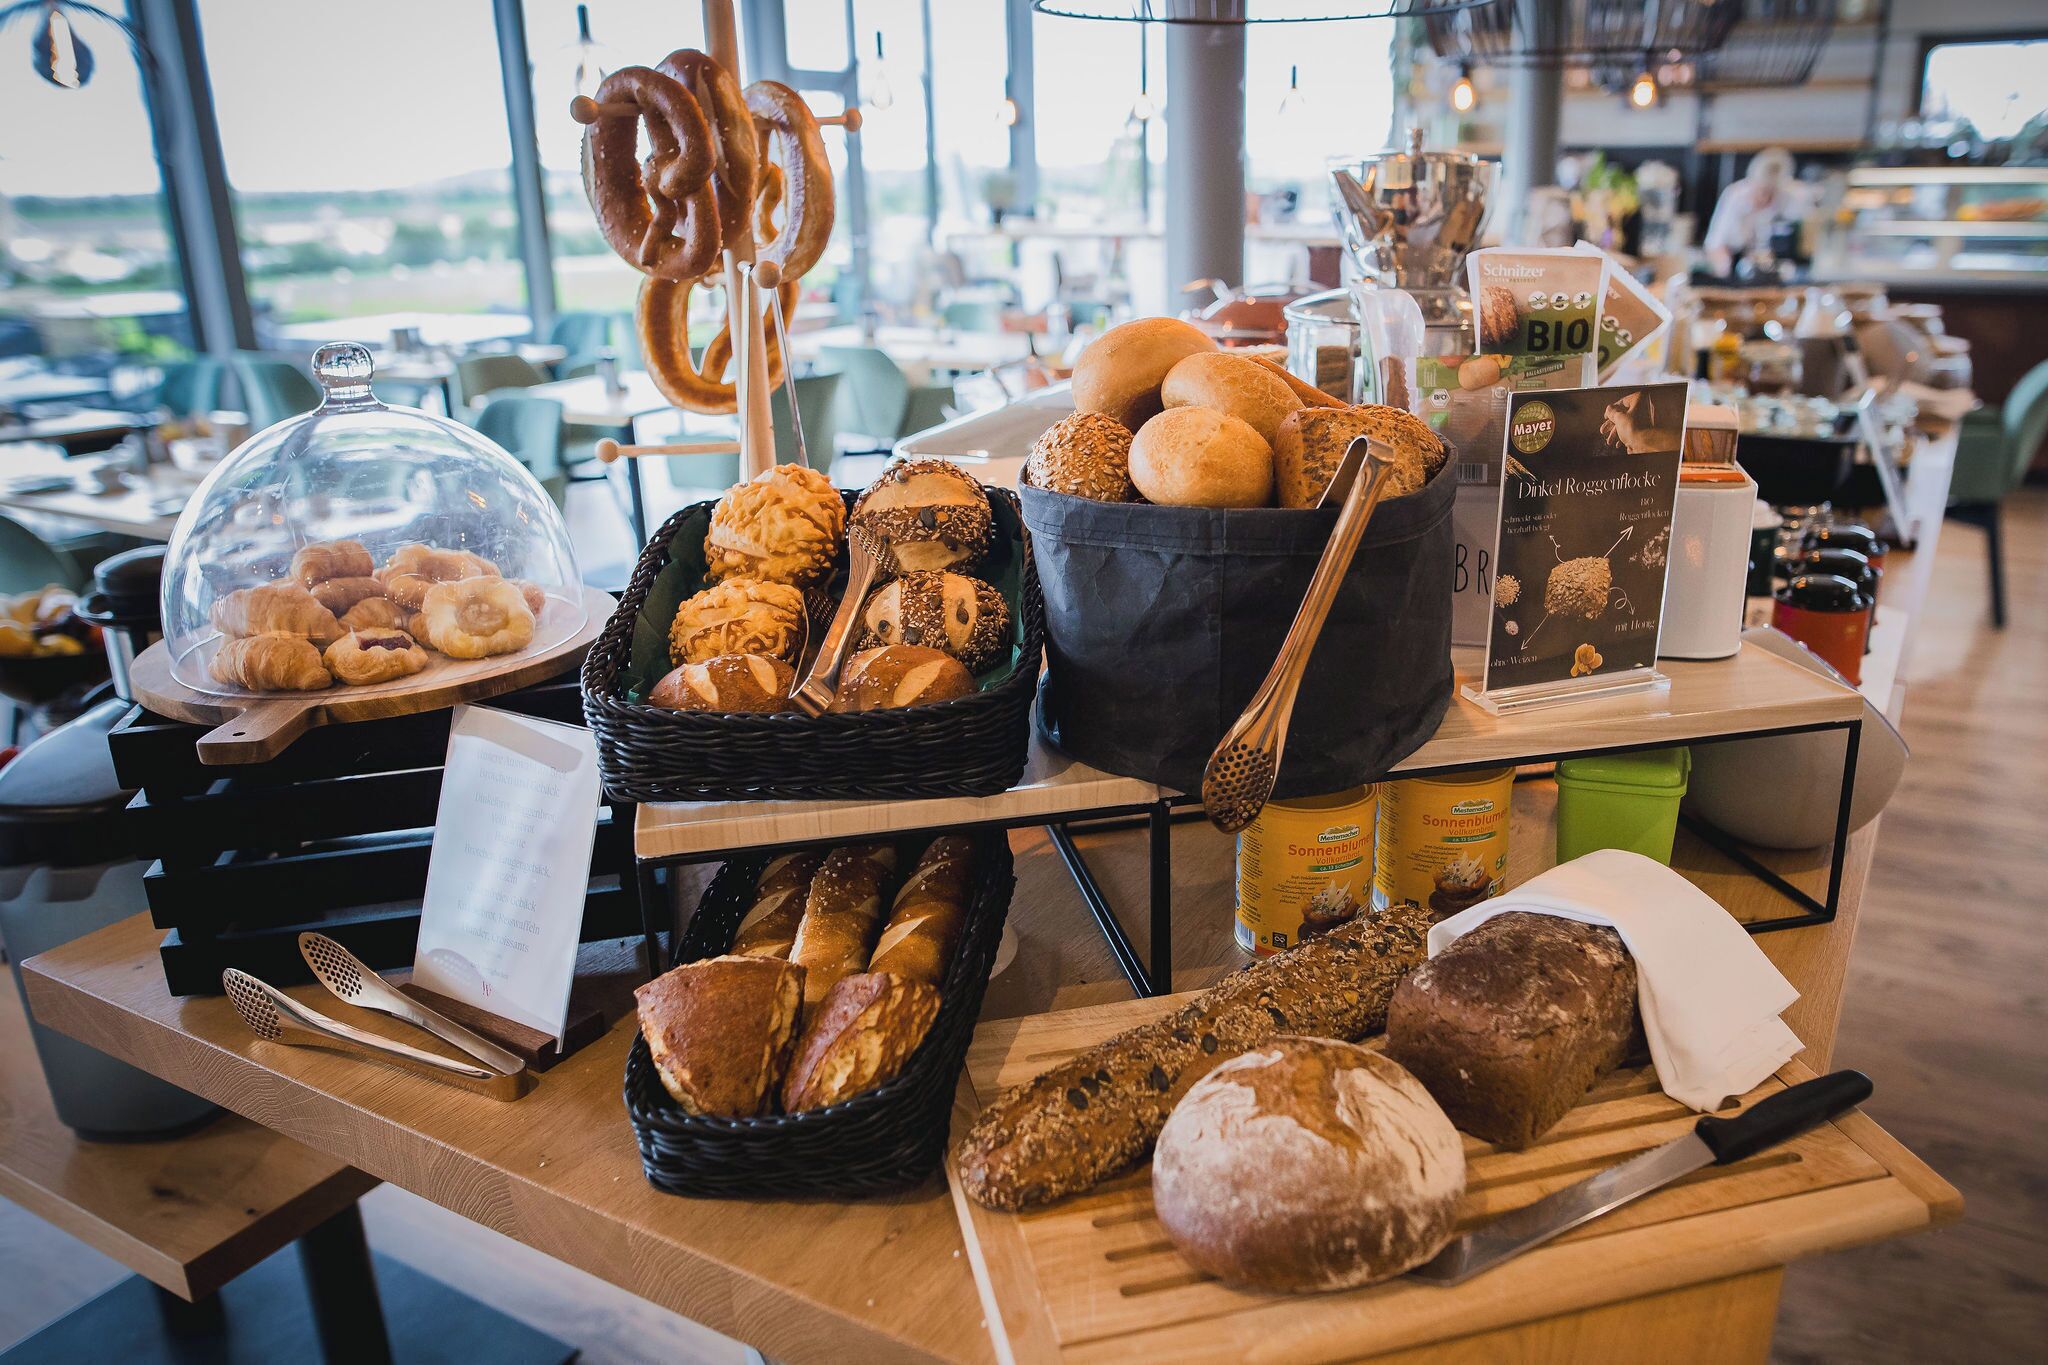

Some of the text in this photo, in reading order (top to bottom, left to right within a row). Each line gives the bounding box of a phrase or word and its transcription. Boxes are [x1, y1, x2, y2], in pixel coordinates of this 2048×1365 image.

[1483, 263, 1544, 278] Schnitzer
[1527, 318, 1590, 353] BIO
[1514, 420, 1552, 437] Mayer
[1519, 471, 1661, 499] Dinkel Roggenflocke
